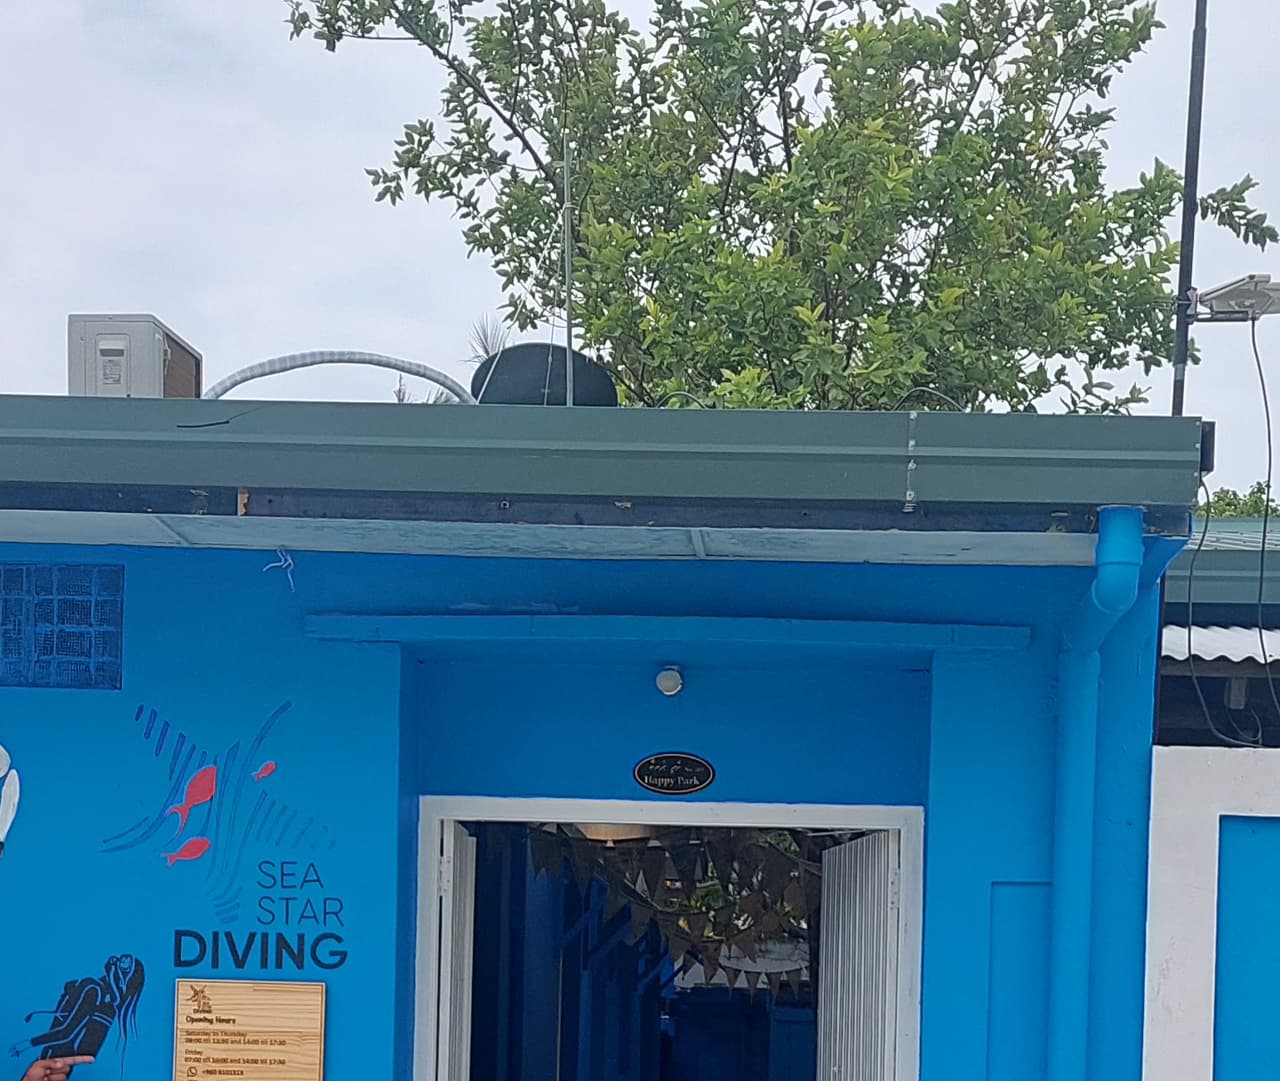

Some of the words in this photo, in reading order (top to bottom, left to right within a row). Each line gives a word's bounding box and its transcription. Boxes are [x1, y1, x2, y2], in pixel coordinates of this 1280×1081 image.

[644, 775, 675, 787] Happy
[678, 775, 700, 785] Park
[256, 860, 324, 889] SEA
[256, 896, 344, 927] STAR
[173, 929, 348, 970] DIVING
[185, 1015, 214, 1025] Opening
[215, 1016, 236, 1024] Hours
